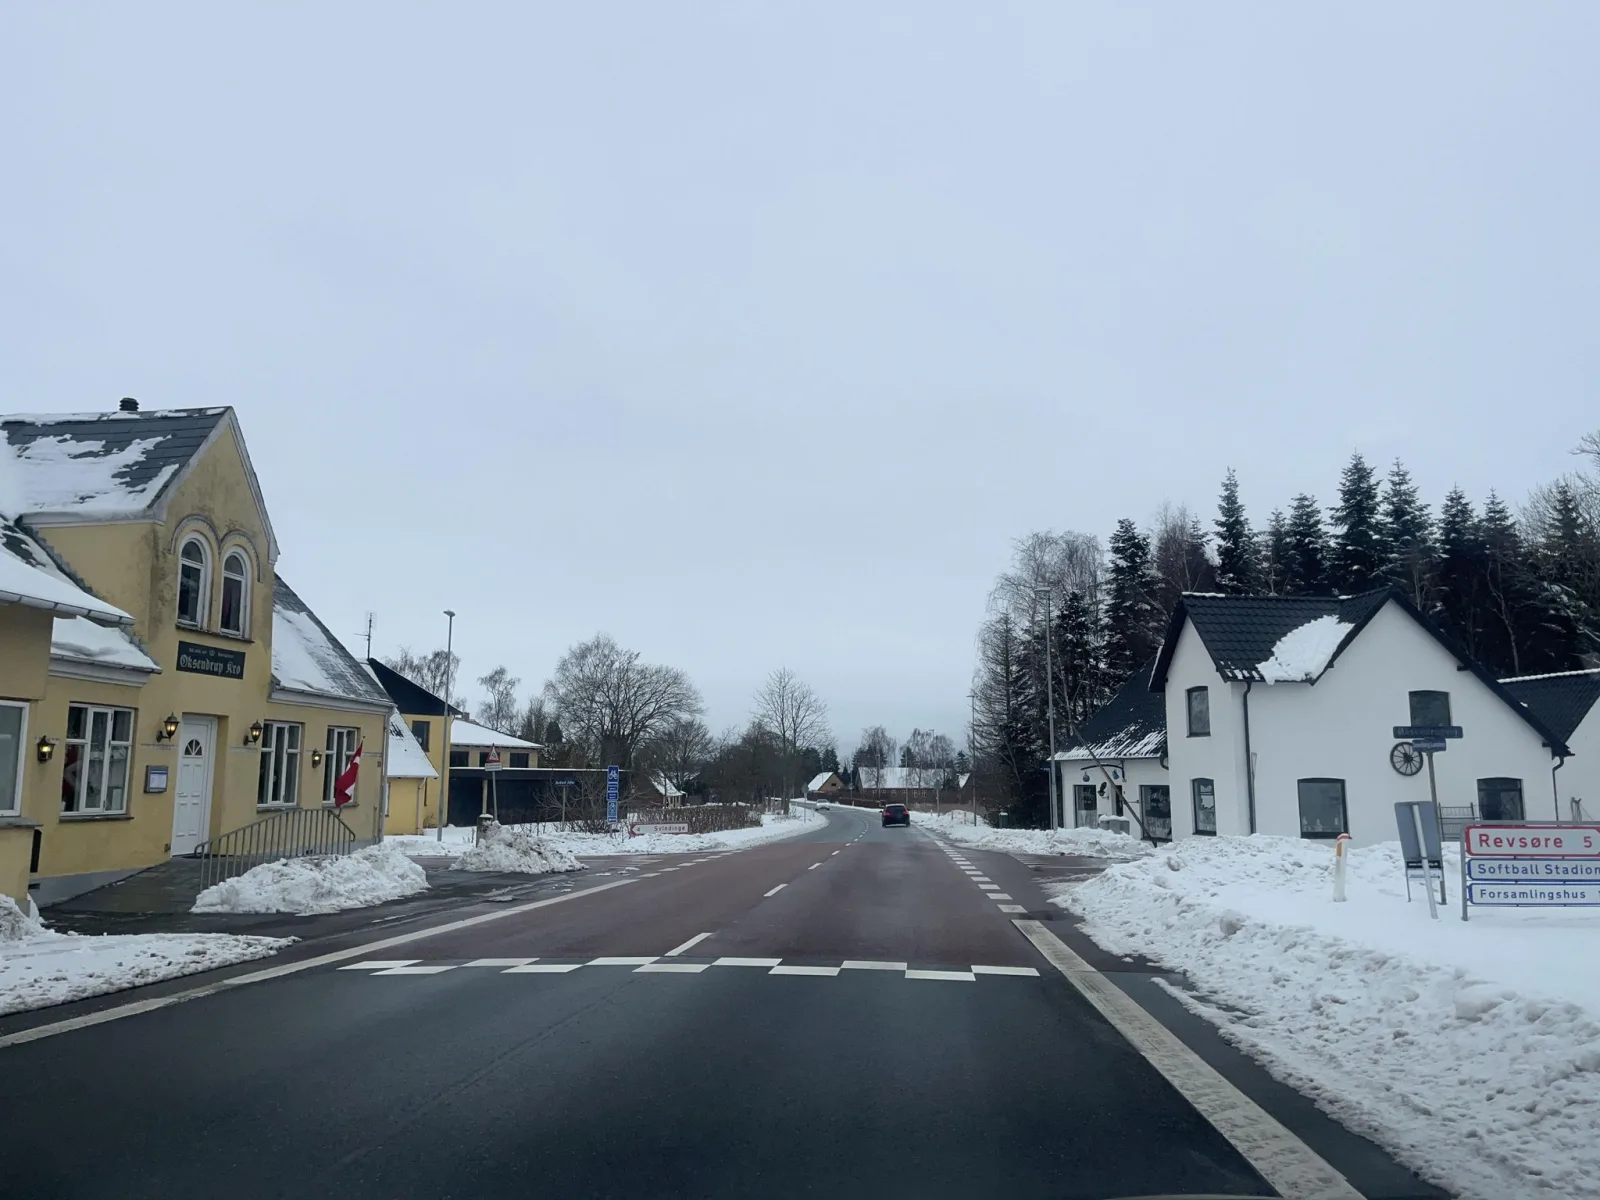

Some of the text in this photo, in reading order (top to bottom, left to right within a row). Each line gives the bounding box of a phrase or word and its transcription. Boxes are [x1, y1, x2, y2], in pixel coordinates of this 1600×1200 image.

[1479, 834, 1592, 848] Revsøre 5
[1478, 864, 1539, 875] Softball
[1480, 889, 1586, 900] Forsamlingshus
